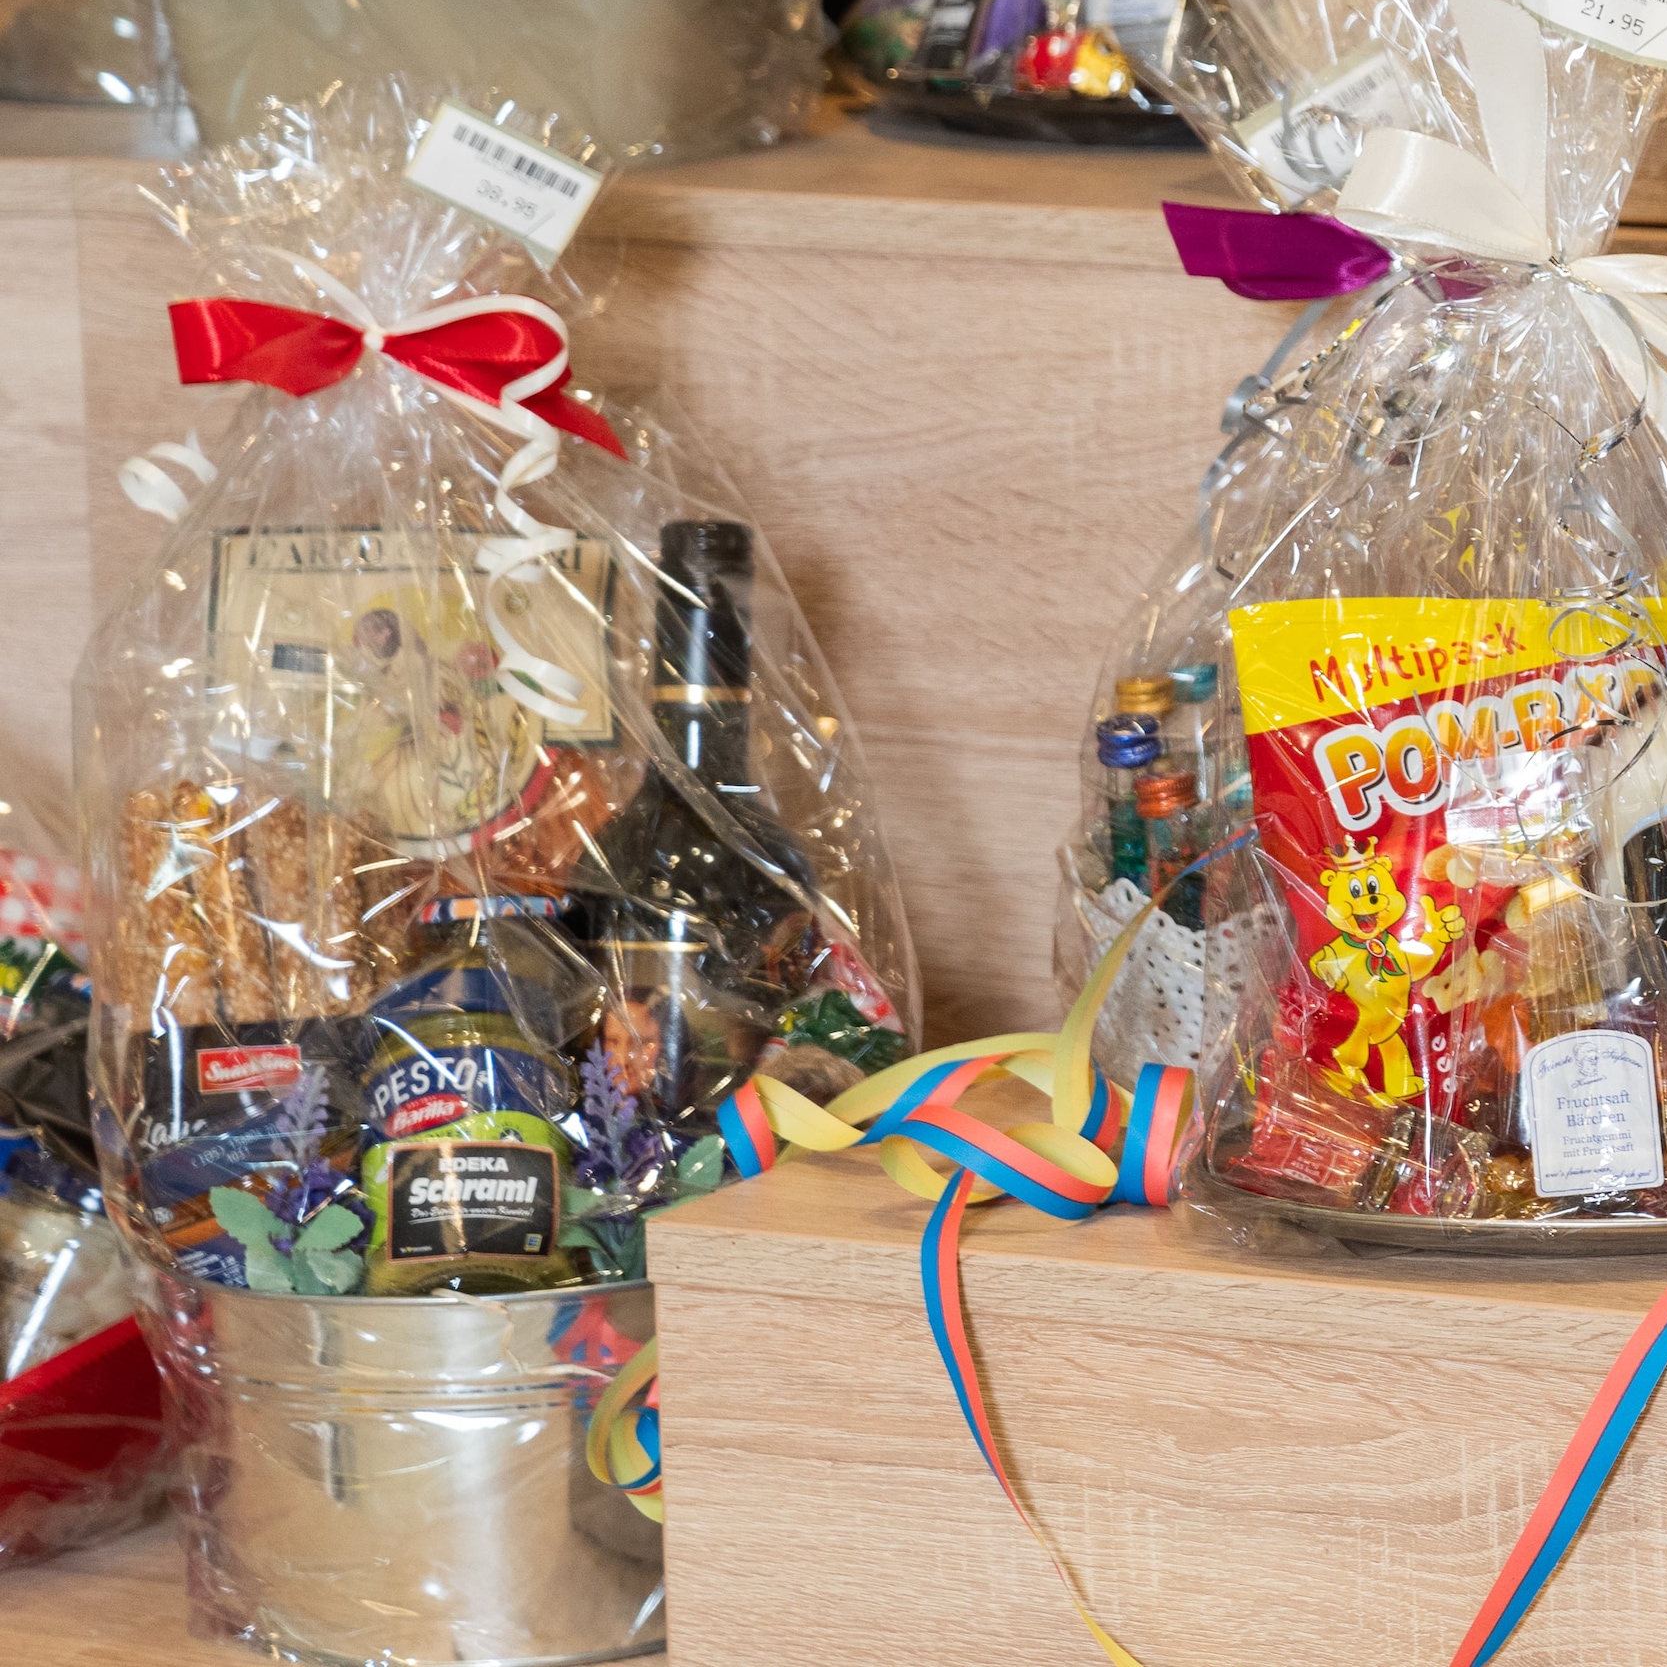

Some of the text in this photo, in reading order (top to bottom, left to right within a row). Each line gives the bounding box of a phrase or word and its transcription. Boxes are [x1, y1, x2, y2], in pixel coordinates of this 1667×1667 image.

[1309, 622, 1526, 703] Multipack
[375, 1058, 480, 1117] PESTO
[1557, 1090, 1631, 1110] Fruchtsaft
[1563, 1142, 1634, 1159] mit Fructsaft
